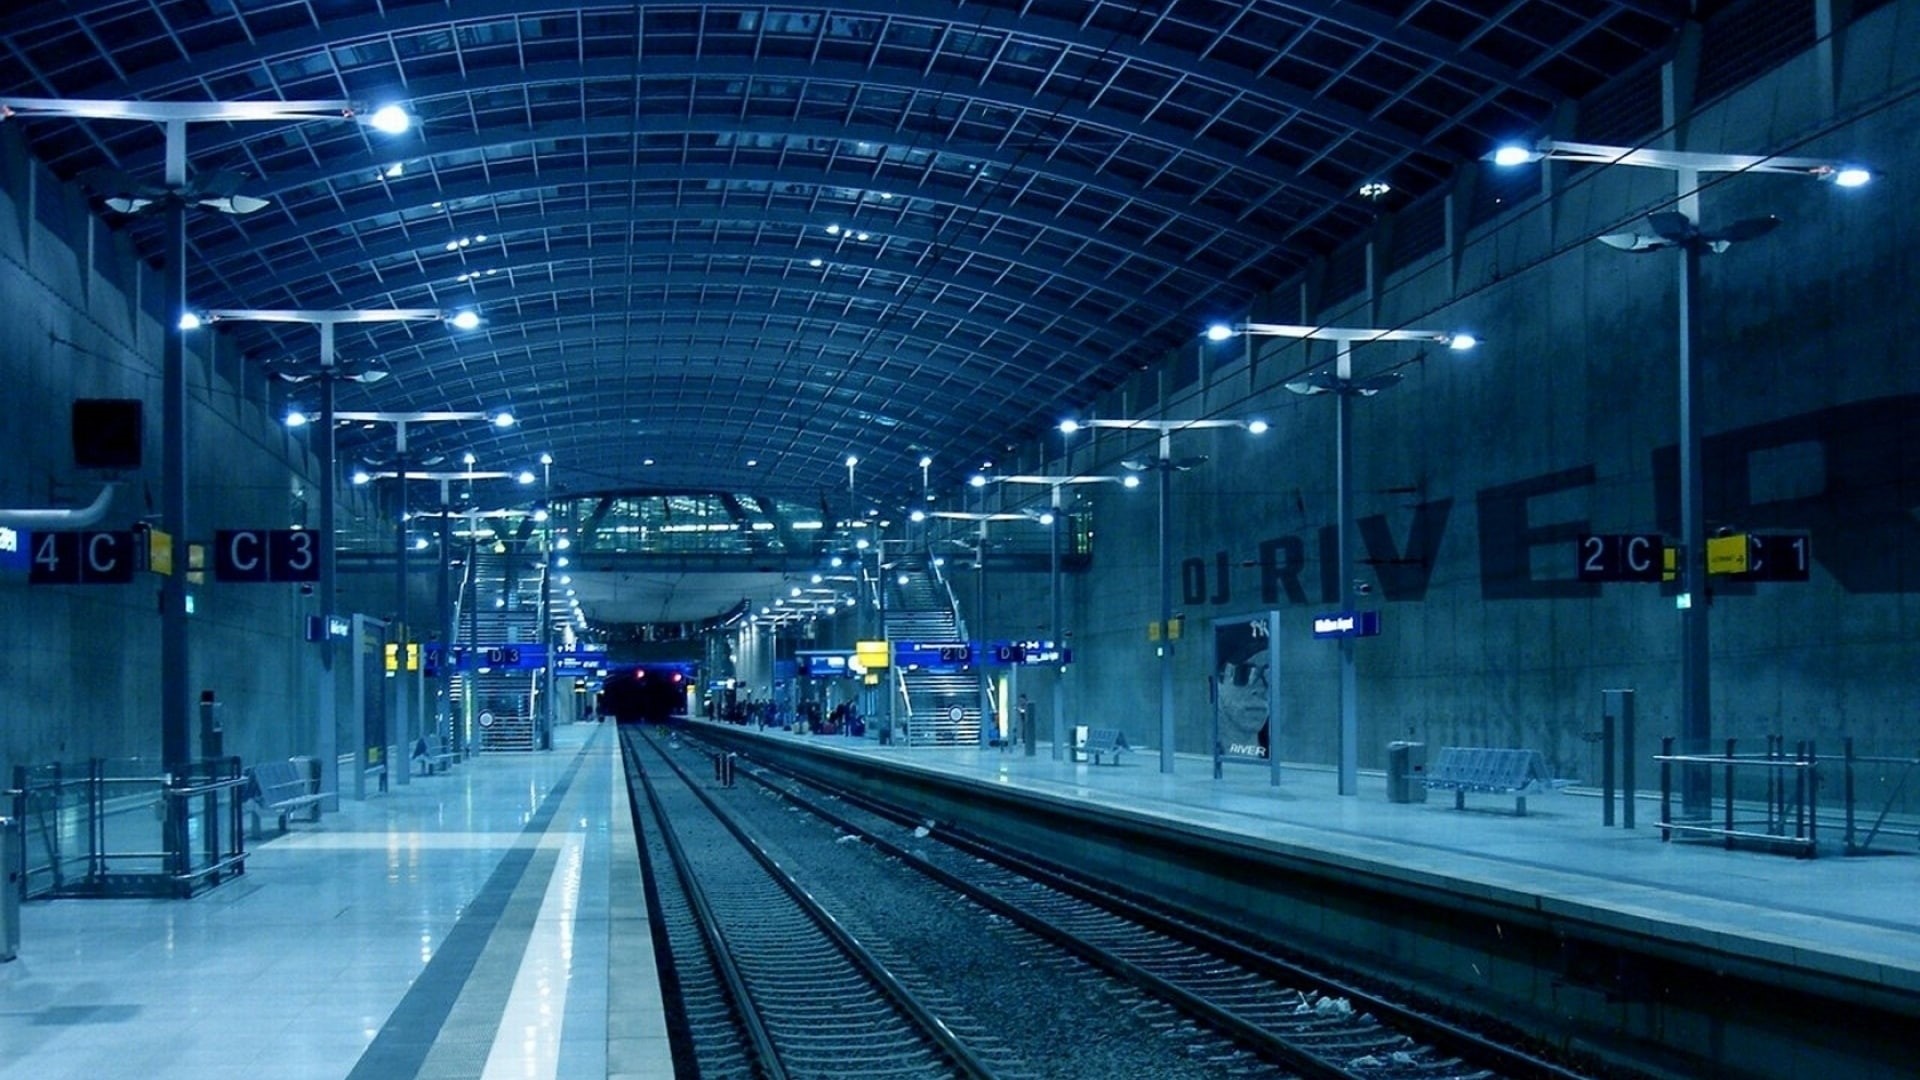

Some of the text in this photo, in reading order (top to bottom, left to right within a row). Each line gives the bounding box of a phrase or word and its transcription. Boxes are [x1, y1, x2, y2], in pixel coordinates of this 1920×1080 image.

[1182, 394, 1920, 606] DJ RIVER
[35, 533, 59, 572] 4
[89, 533, 116, 572] C
[231, 532, 312, 570] C 3
[1584, 537, 1650, 571] 2 C
[1792, 538, 1804, 571] 1
[509, 648, 519, 662] 3
[1230, 743, 1266, 757] RIVER
